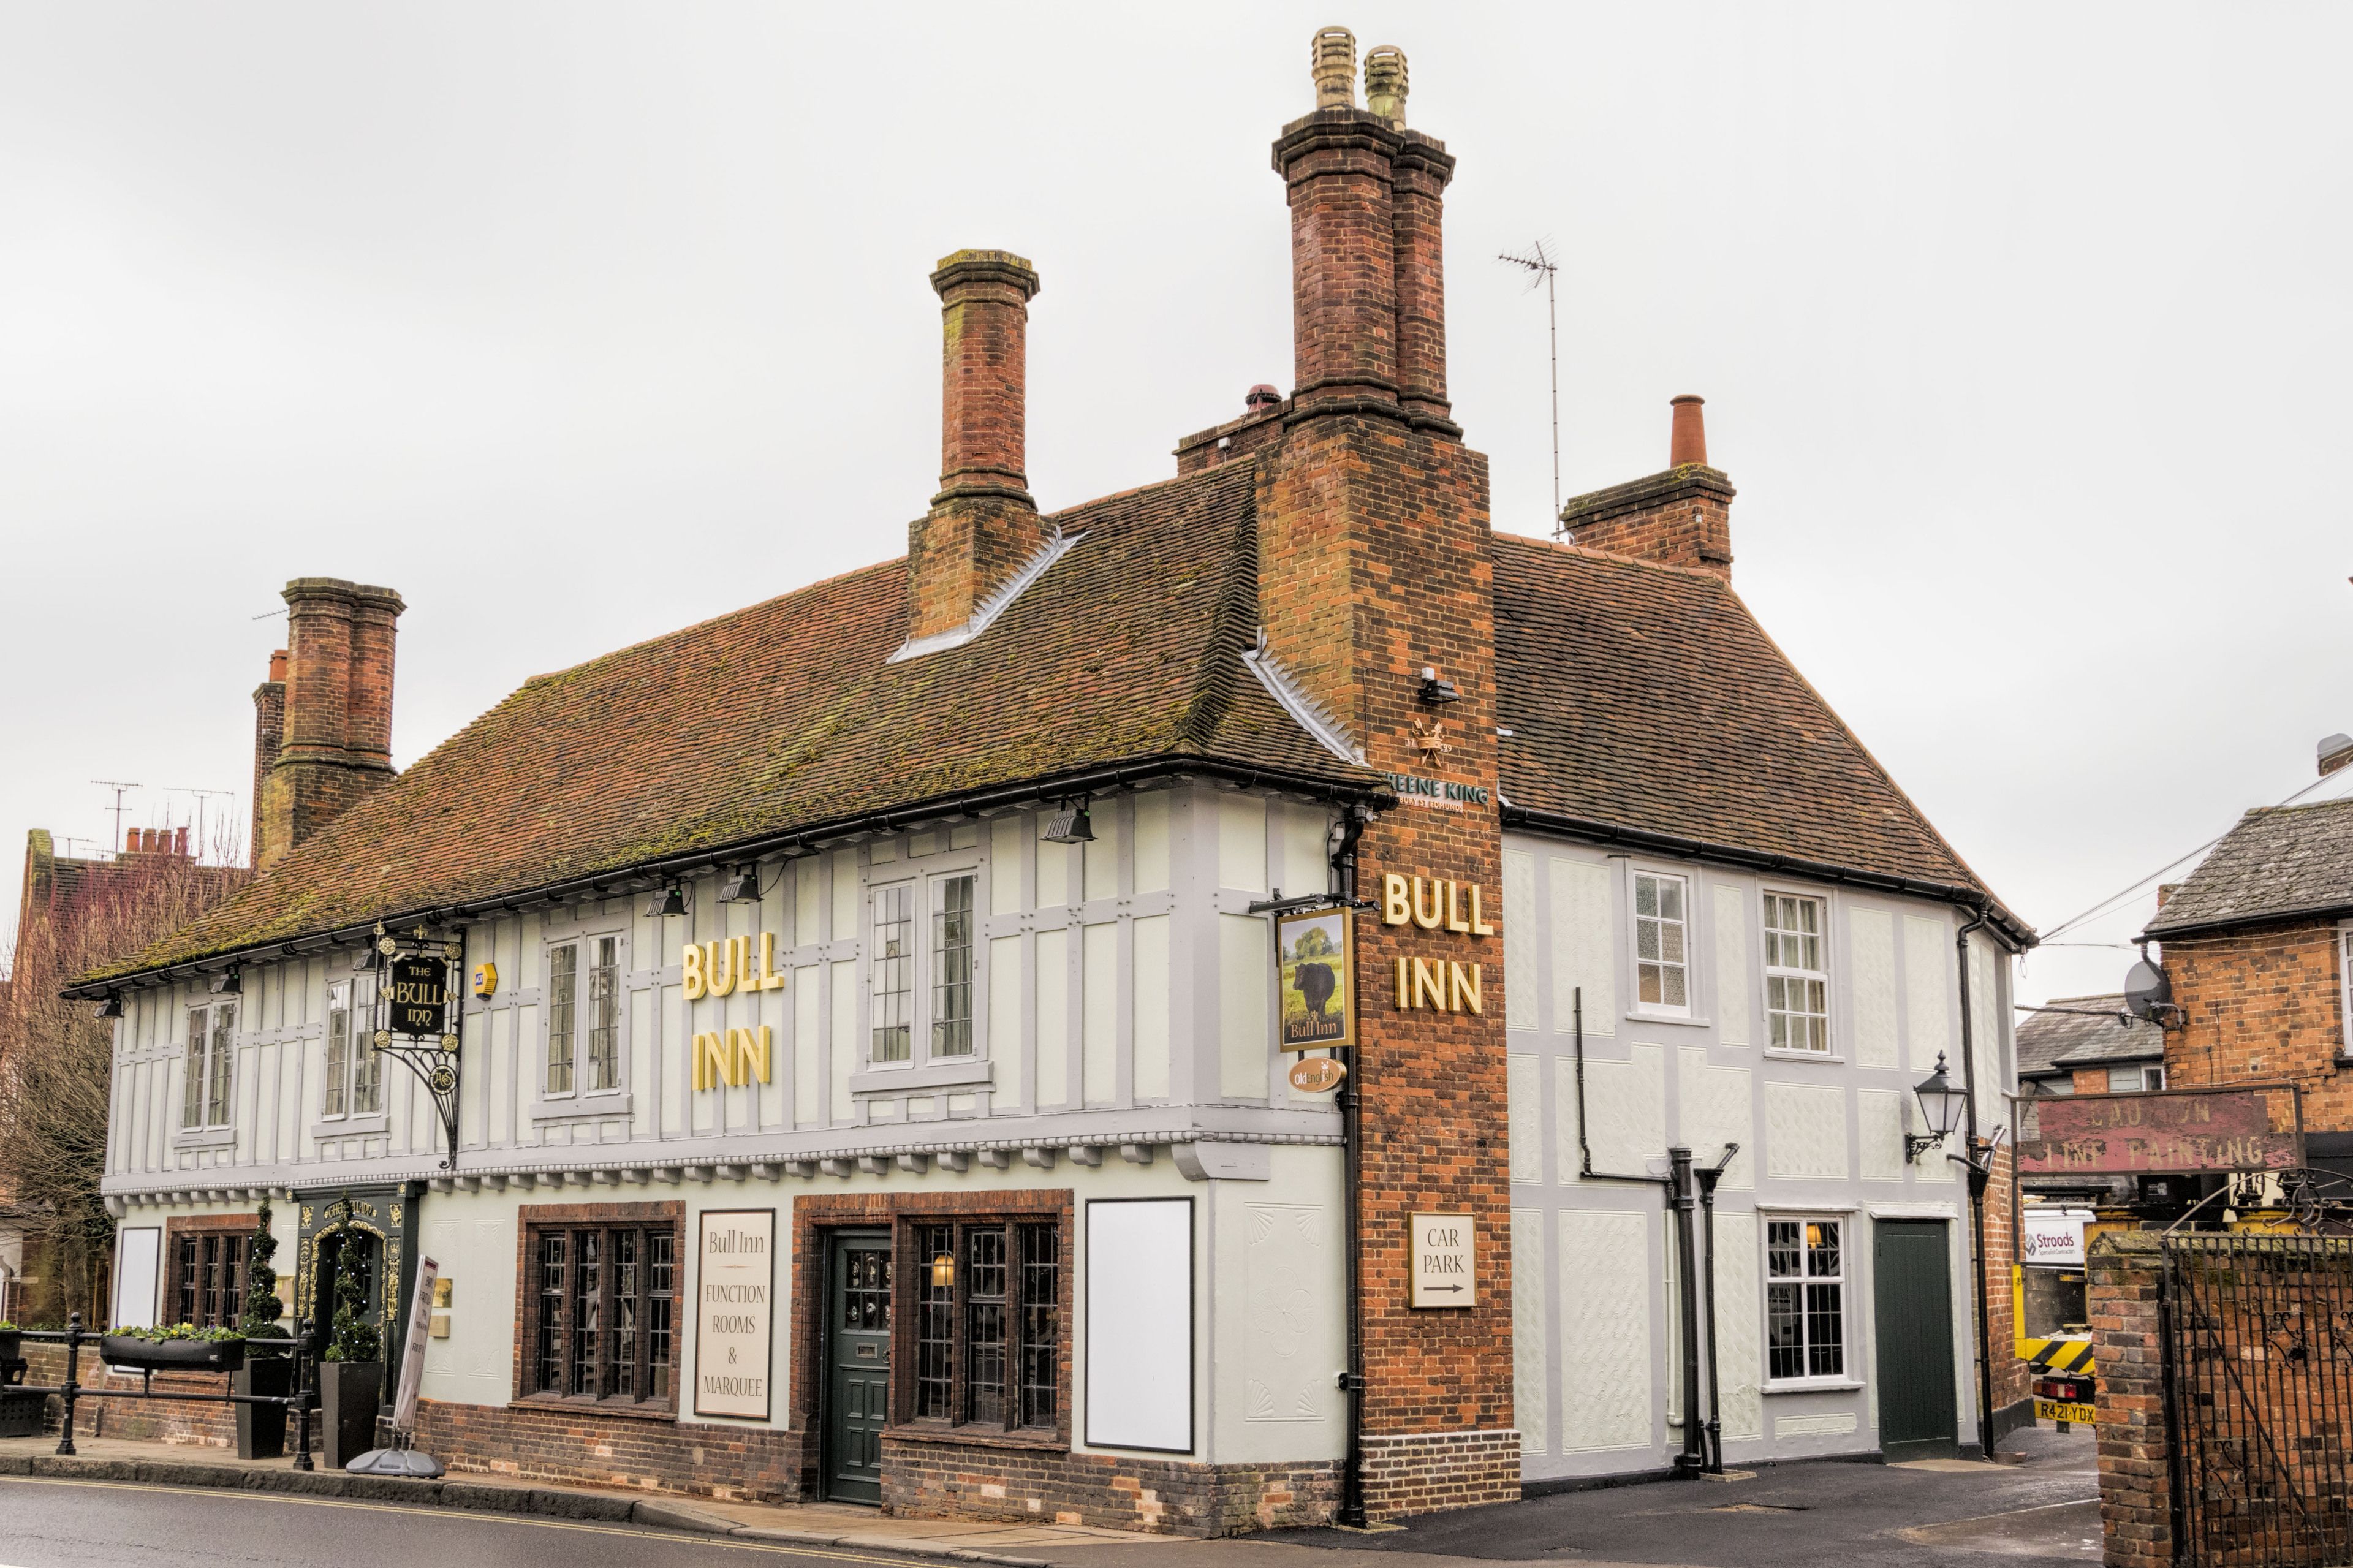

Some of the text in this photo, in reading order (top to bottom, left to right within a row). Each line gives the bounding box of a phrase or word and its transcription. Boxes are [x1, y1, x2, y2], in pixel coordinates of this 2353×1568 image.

[1386, 773, 1489, 804] REENE KING
[1399, 796, 1463, 811] BURY ST EDMUNDS
[1382, 873, 1493, 936] BULL
[408, 966, 431, 977] THE
[683, 932, 784, 1000] BULL
[396, 982, 442, 1006] BULL
[1393, 957, 1482, 1013] INN
[1291, 1020, 1337, 1038] Bull Inn
[692, 1026, 770, 1091] INN
[2128, 1136, 2263, 1167] PAINTING
[708, 1230, 764, 1254] Bull Inn
[1427, 1228, 1460, 1247] CAR
[2037, 1232, 2074, 1248] Stroods
[1423, 1254, 1464, 1273] PARK
[705, 1284, 766, 1303] FUNCTION
[712, 1314, 756, 1334] ROOMS
[728, 1346, 737, 1365] &
[703, 1376, 762, 1398] MARQUEE
[2040, 1402, 2094, 1422] R421 YDX
